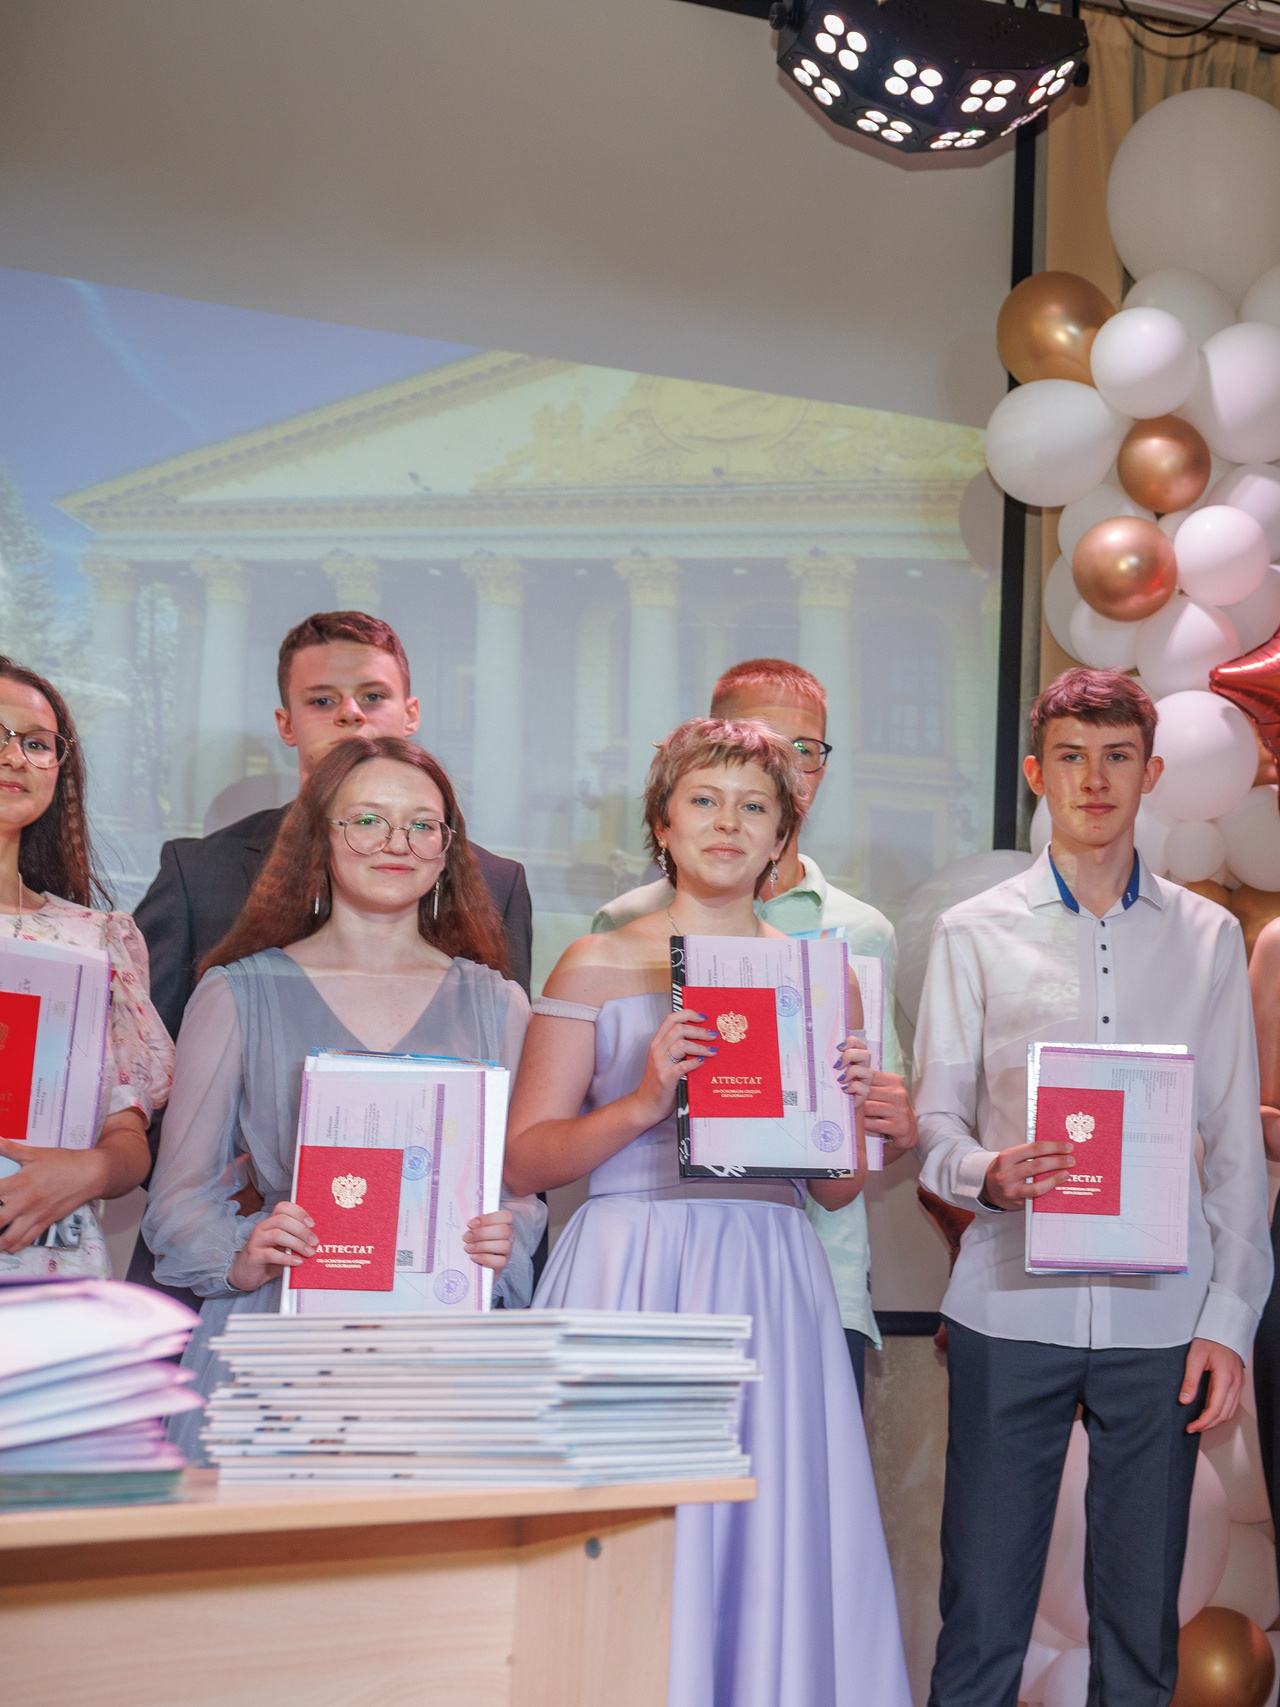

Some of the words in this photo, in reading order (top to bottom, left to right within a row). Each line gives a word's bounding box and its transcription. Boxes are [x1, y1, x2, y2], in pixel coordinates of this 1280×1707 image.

[710, 1076, 763, 1085] АТТЕСТАТ
[1067, 1174, 1103, 1183] ТЕСТАТ
[315, 1244, 375, 1254] АТТЕСТАТ
